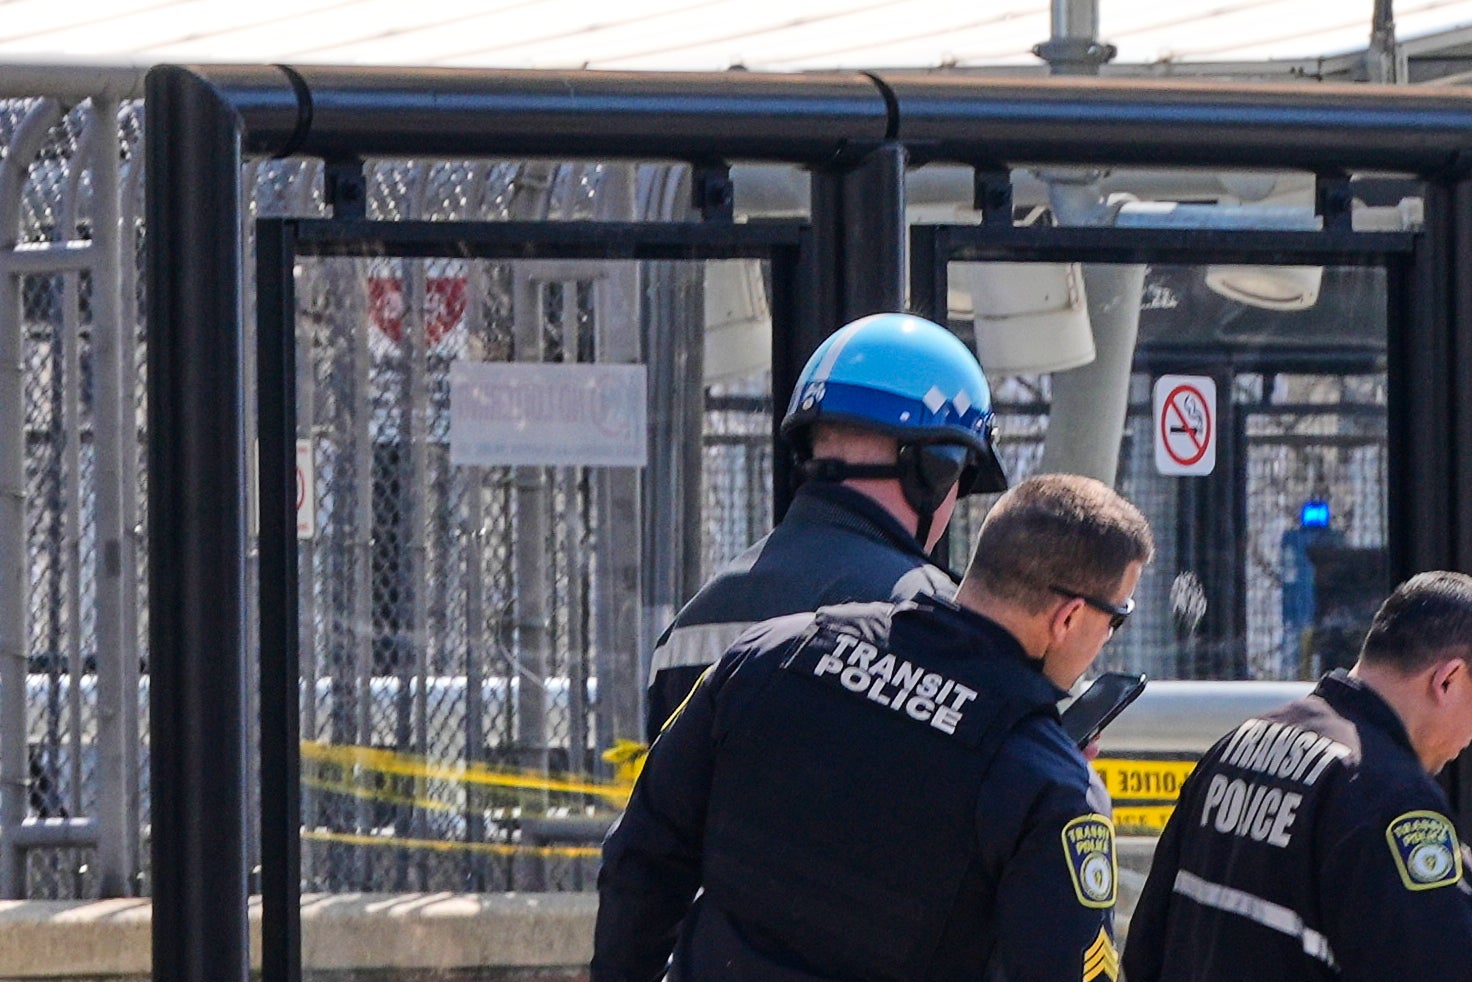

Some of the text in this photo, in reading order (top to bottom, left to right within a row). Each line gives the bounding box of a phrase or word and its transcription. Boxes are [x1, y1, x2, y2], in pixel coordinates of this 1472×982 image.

[813, 653, 963, 735] POLICE
[832, 633, 978, 712] TRANSIT
[1118, 769, 1188, 793] OLICE
[1219, 718, 1351, 786] TRANSIT
[1200, 773, 1303, 848] POLICE
